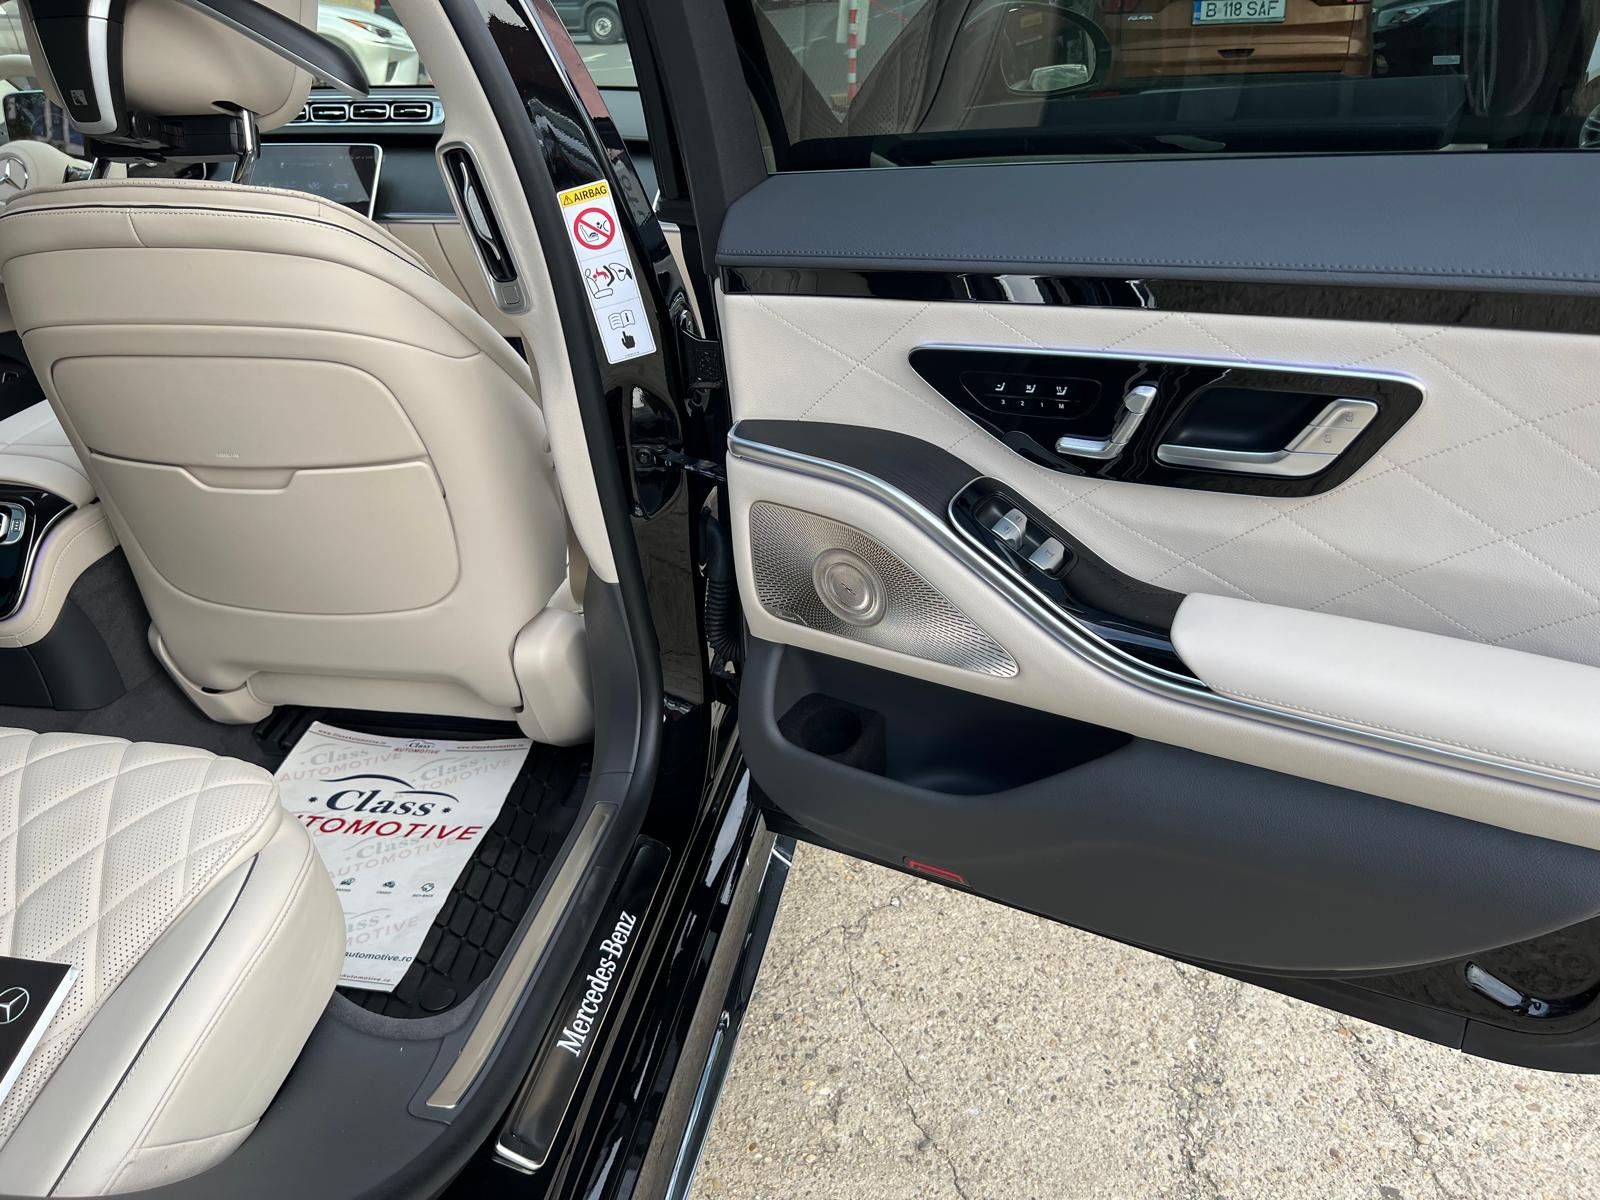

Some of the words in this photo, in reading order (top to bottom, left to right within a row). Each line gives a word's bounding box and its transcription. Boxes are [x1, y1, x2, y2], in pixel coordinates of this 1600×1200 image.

[1205, 2, 1217, 18] B
[1223, 1, 1243, 17] 118
[1246, 0, 1279, 17] SAF
[573, 184, 608, 203] AIRBAG
[310, 748, 369, 766] Class
[280, 752, 402, 782] AUTOMOTIVE
[326, 789, 436, 817] Class
[298, 814, 484, 840] TOMOTIVE
[347, 915, 380, 933] ass
[345, 951, 413, 962] automotive.ro
[556, 910, 637, 1058] Mercedes-Benz
